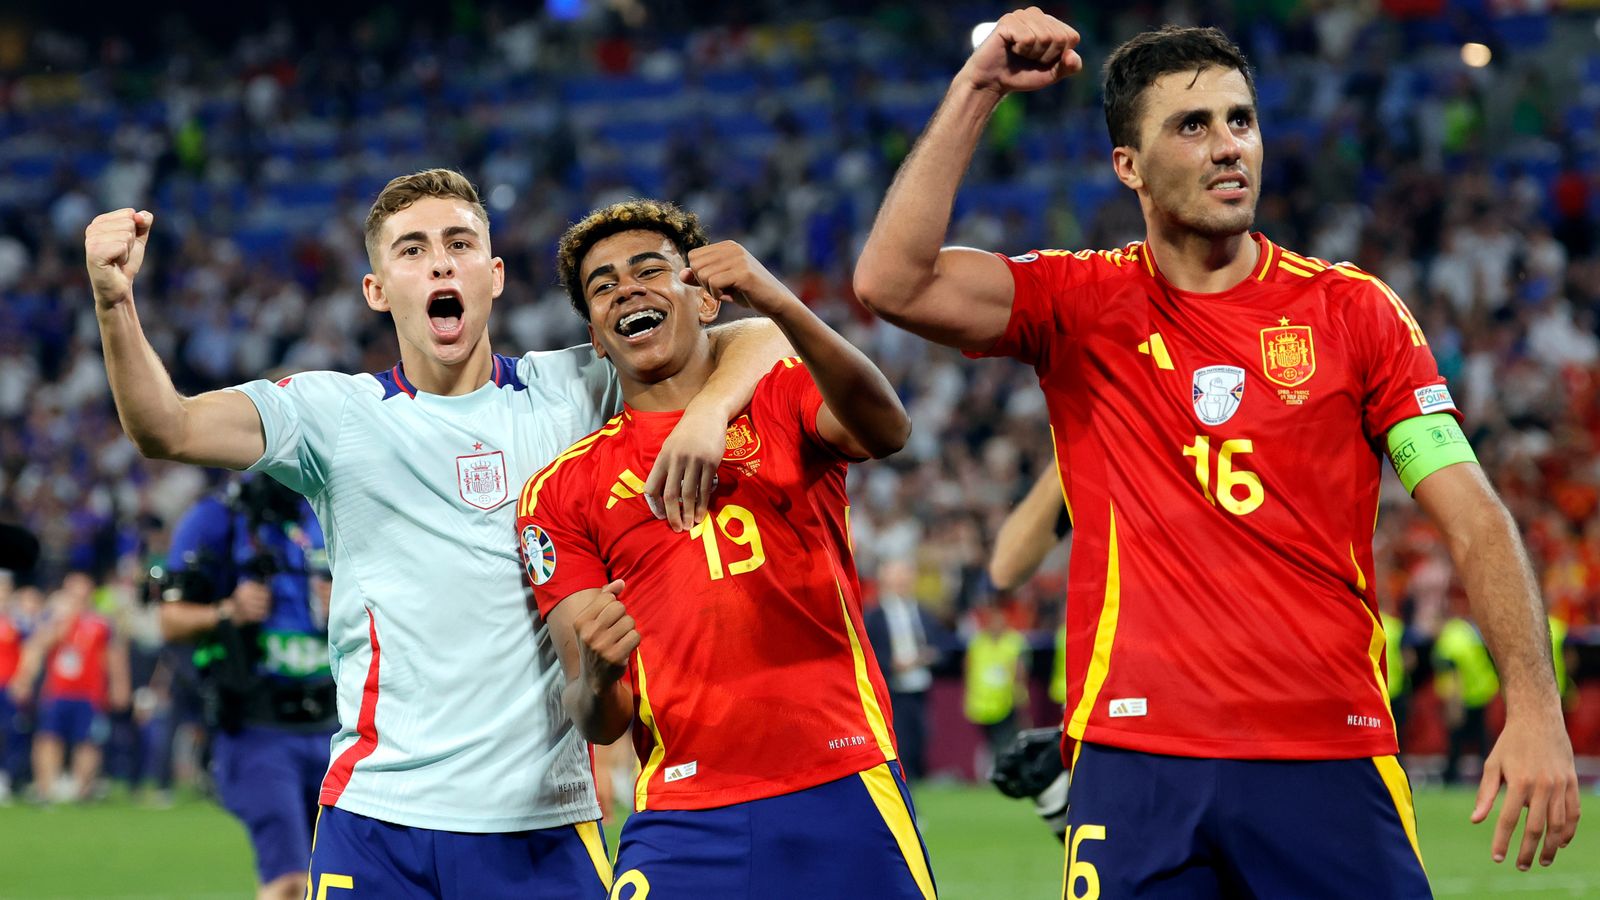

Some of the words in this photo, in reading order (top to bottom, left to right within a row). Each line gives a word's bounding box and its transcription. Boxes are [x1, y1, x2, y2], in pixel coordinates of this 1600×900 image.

[1183, 435, 1265, 515] 16
[690, 504, 766, 581] 19
[828, 735, 866, 750] HEAT.RDY
[1347, 714, 1381, 728] HEAT.RDY
